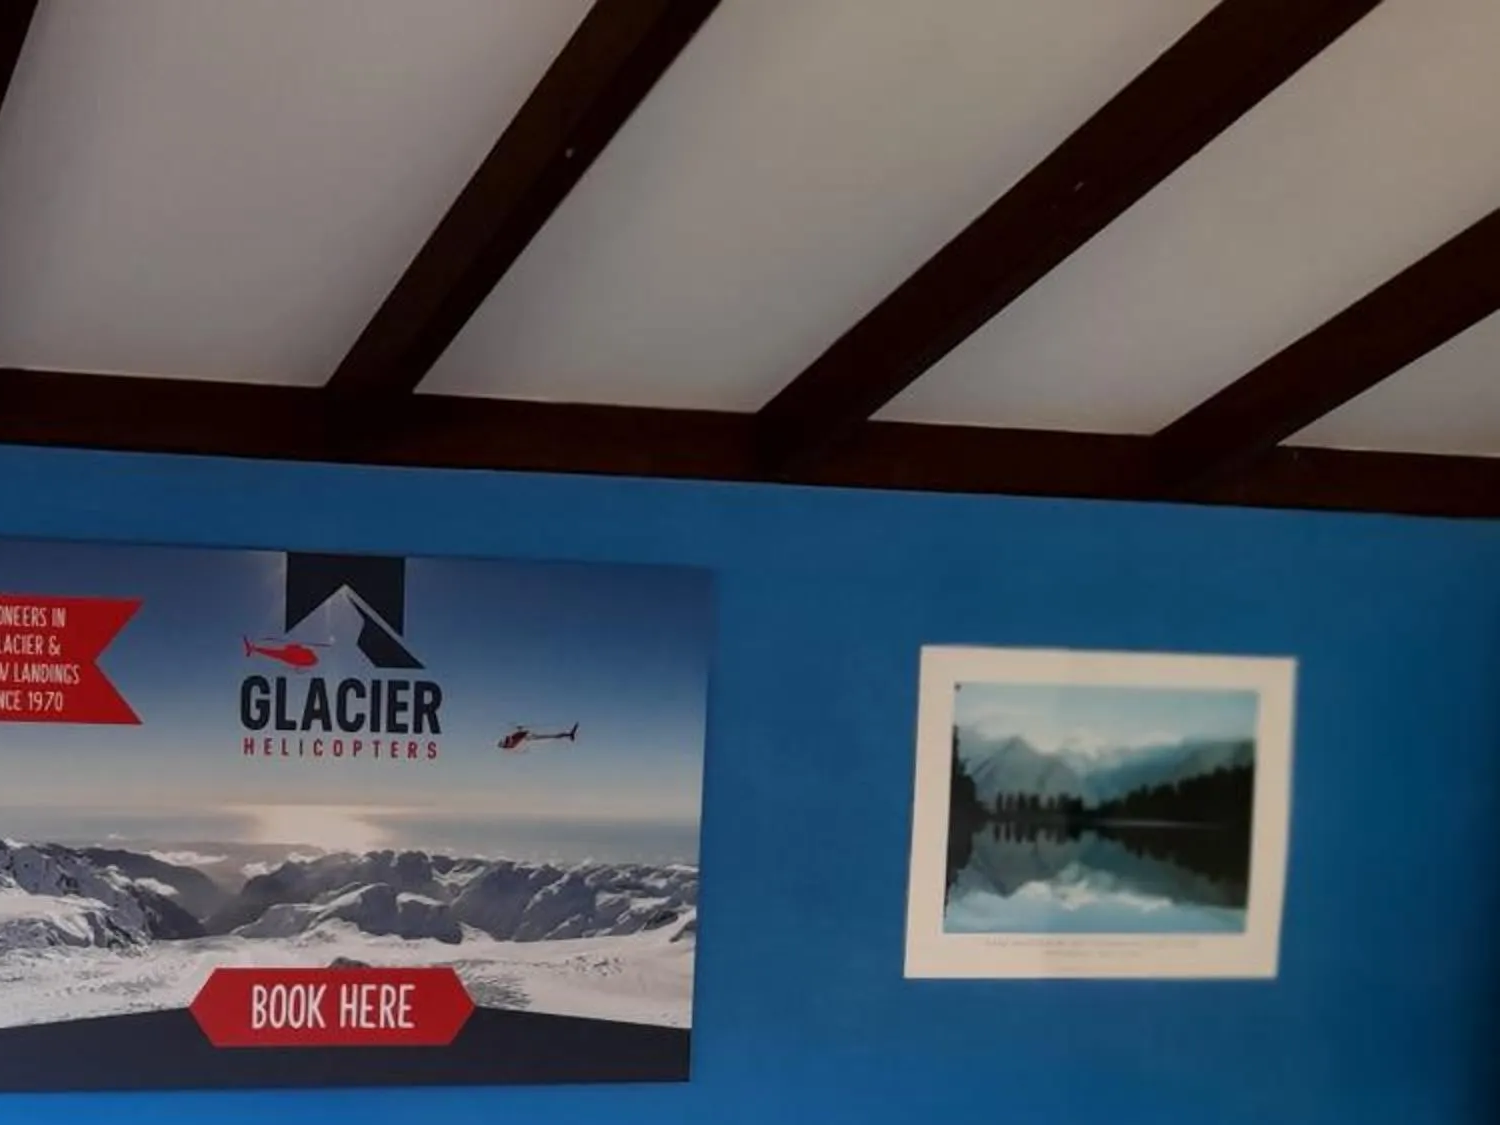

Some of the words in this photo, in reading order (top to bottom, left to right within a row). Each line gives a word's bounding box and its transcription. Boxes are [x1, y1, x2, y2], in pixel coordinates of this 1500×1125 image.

[51, 607, 66, 628] IN
[48, 635, 62, 657] &
[13, 662, 81, 685] LANDINGS
[27, 691, 64, 712] 1970
[240, 674, 443, 734] GLACIER
[243, 737, 438, 759] HELICOPTERS
[252, 983, 328, 1029] BOOK
[339, 983, 416, 1029] HERE
